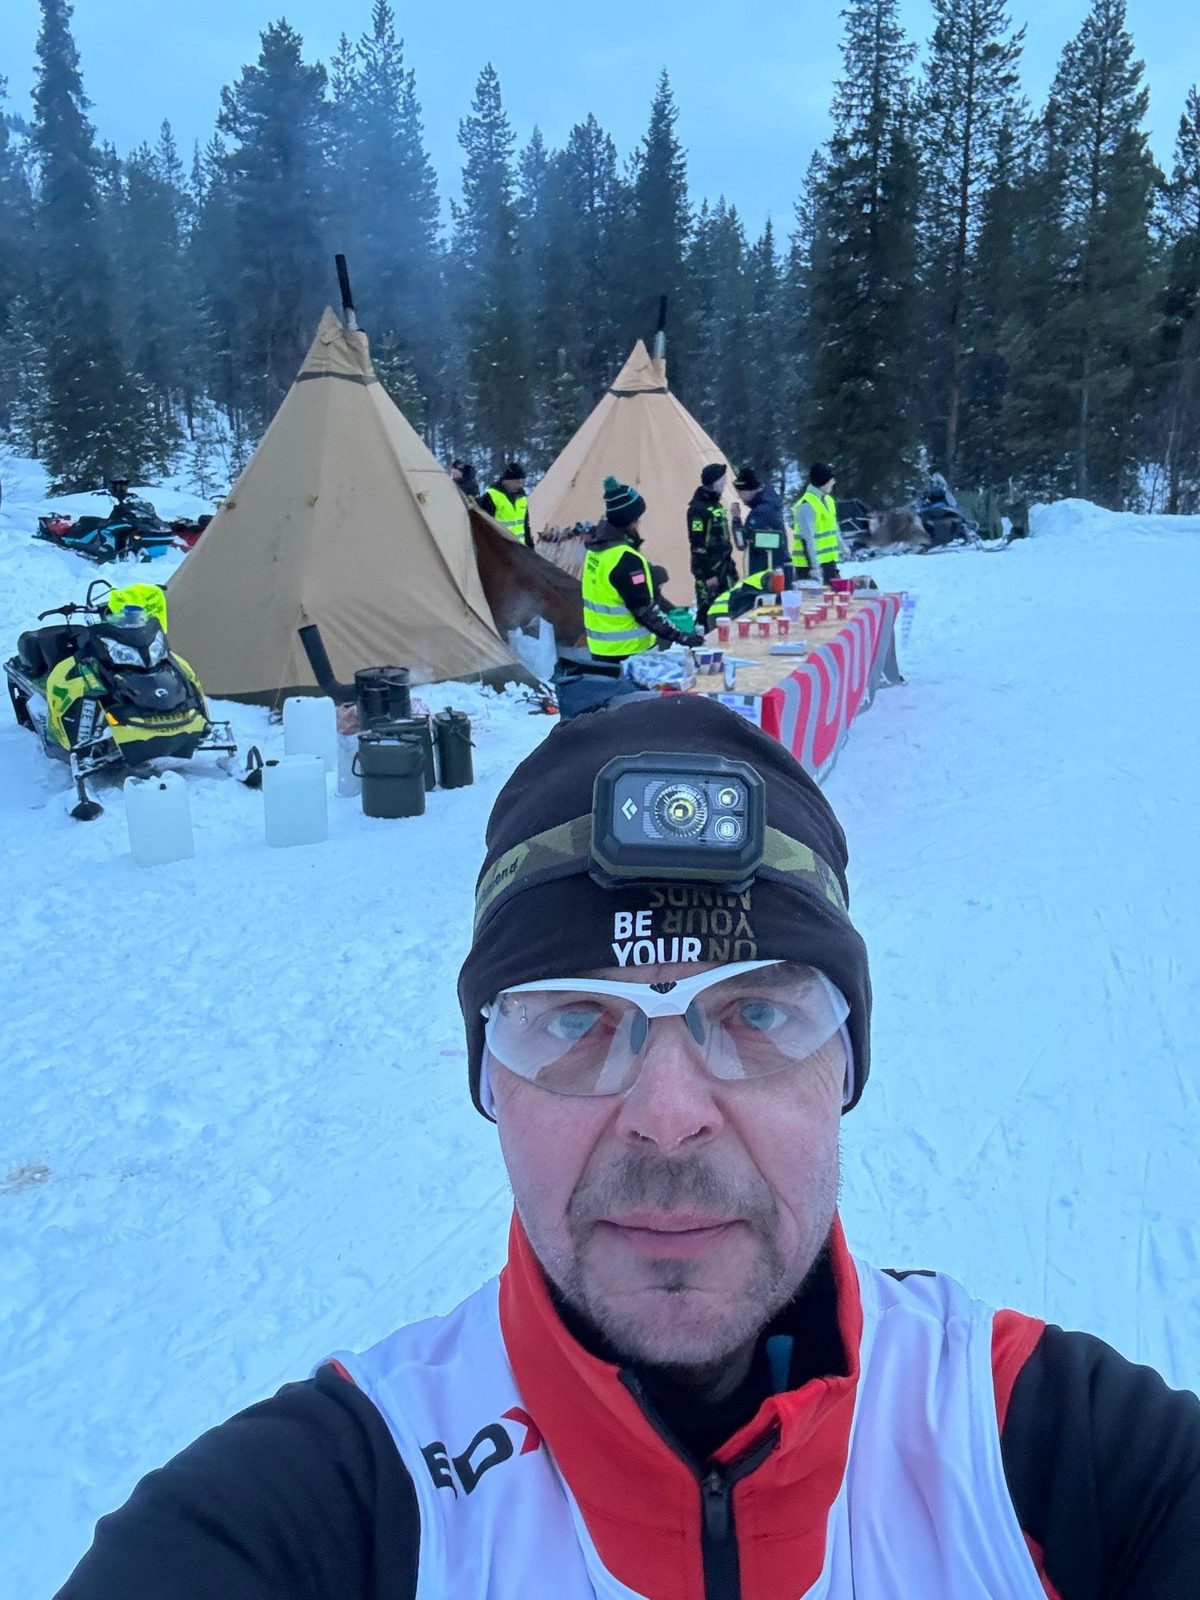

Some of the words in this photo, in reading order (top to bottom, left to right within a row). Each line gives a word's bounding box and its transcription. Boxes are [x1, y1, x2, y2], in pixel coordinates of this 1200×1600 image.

[614, 910, 653, 940] BE
[661, 908, 755, 938] YOUR
[611, 937, 701, 967] YOUR
